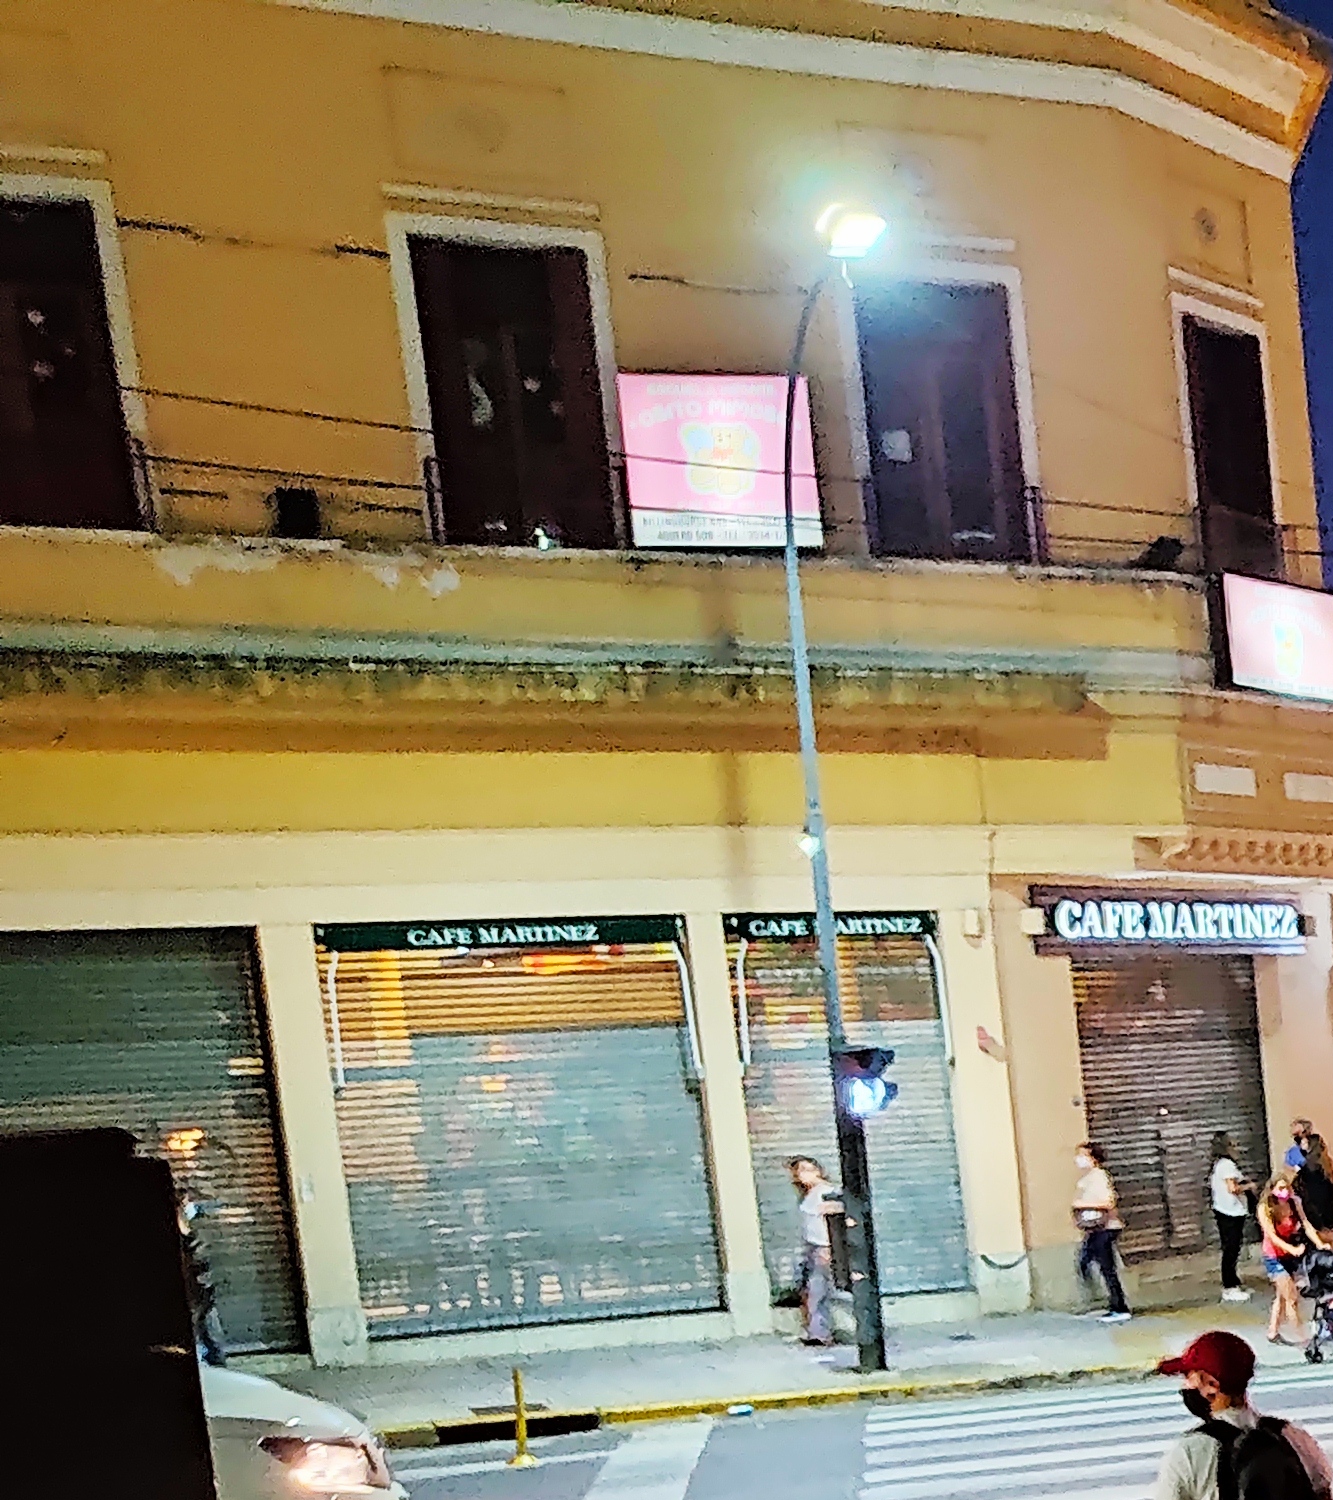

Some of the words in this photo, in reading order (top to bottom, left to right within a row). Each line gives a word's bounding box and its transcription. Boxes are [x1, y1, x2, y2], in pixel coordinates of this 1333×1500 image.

[750, 919, 809, 936] CAFE
[813, 916, 923, 935] ARTINEZ
[1055, 899, 1145, 940] CAFE
[1146, 901, 1299, 939] MARTINEZ
[407, 927, 473, 946] CAFE
[478, 924, 599, 944] MARTINEZ
